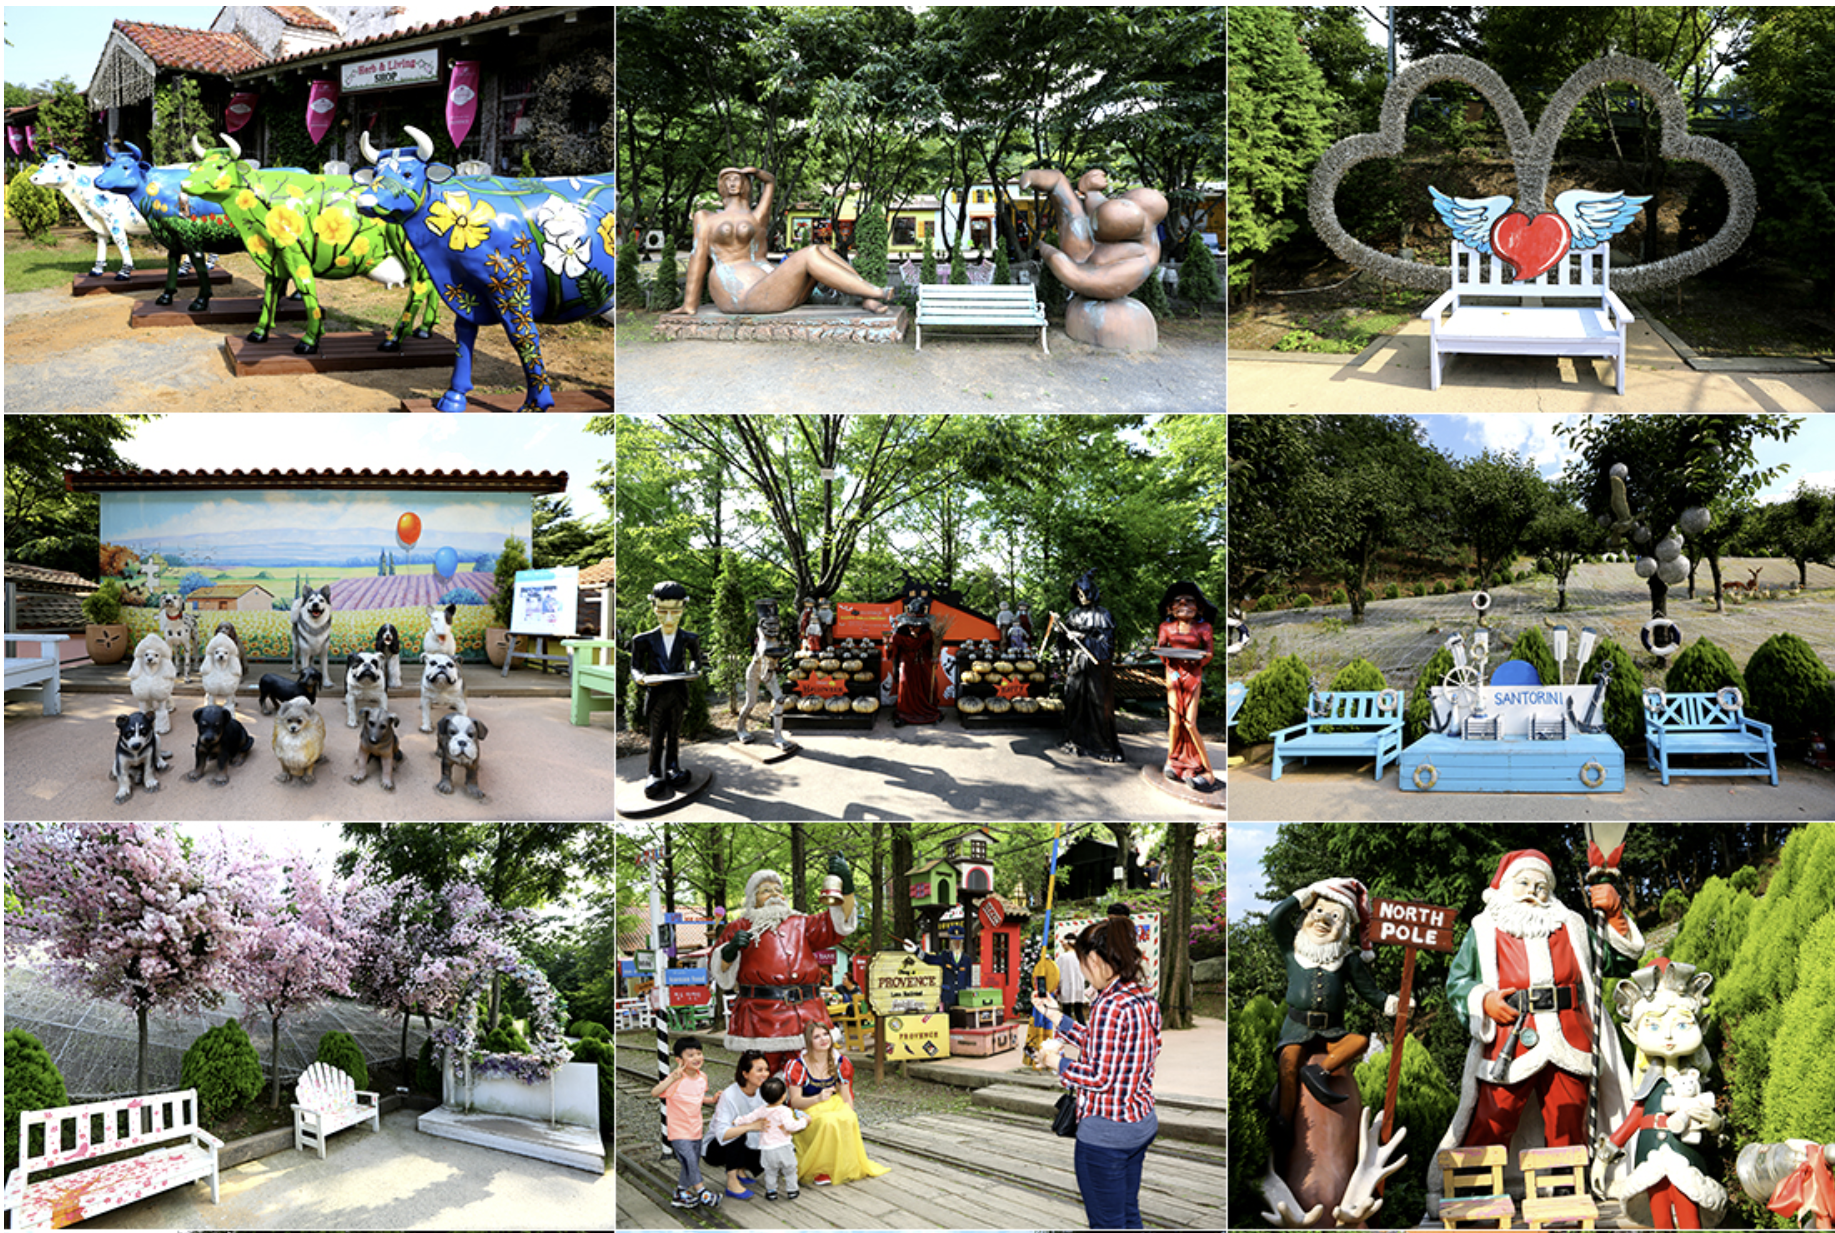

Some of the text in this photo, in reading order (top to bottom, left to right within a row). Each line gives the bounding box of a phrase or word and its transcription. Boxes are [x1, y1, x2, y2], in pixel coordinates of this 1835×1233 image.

[358, 58, 416, 75] Herb & Living
[374, 71, 398, 83] SHOP
[1494, 691, 1564, 706] SANTORINI
[1379, 902, 1444, 927] NORTH
[1380, 922, 1438, 945] POLE
[878, 976, 936, 988] PROVENCE
[899, 1031, 939, 1040] PROVENCE
